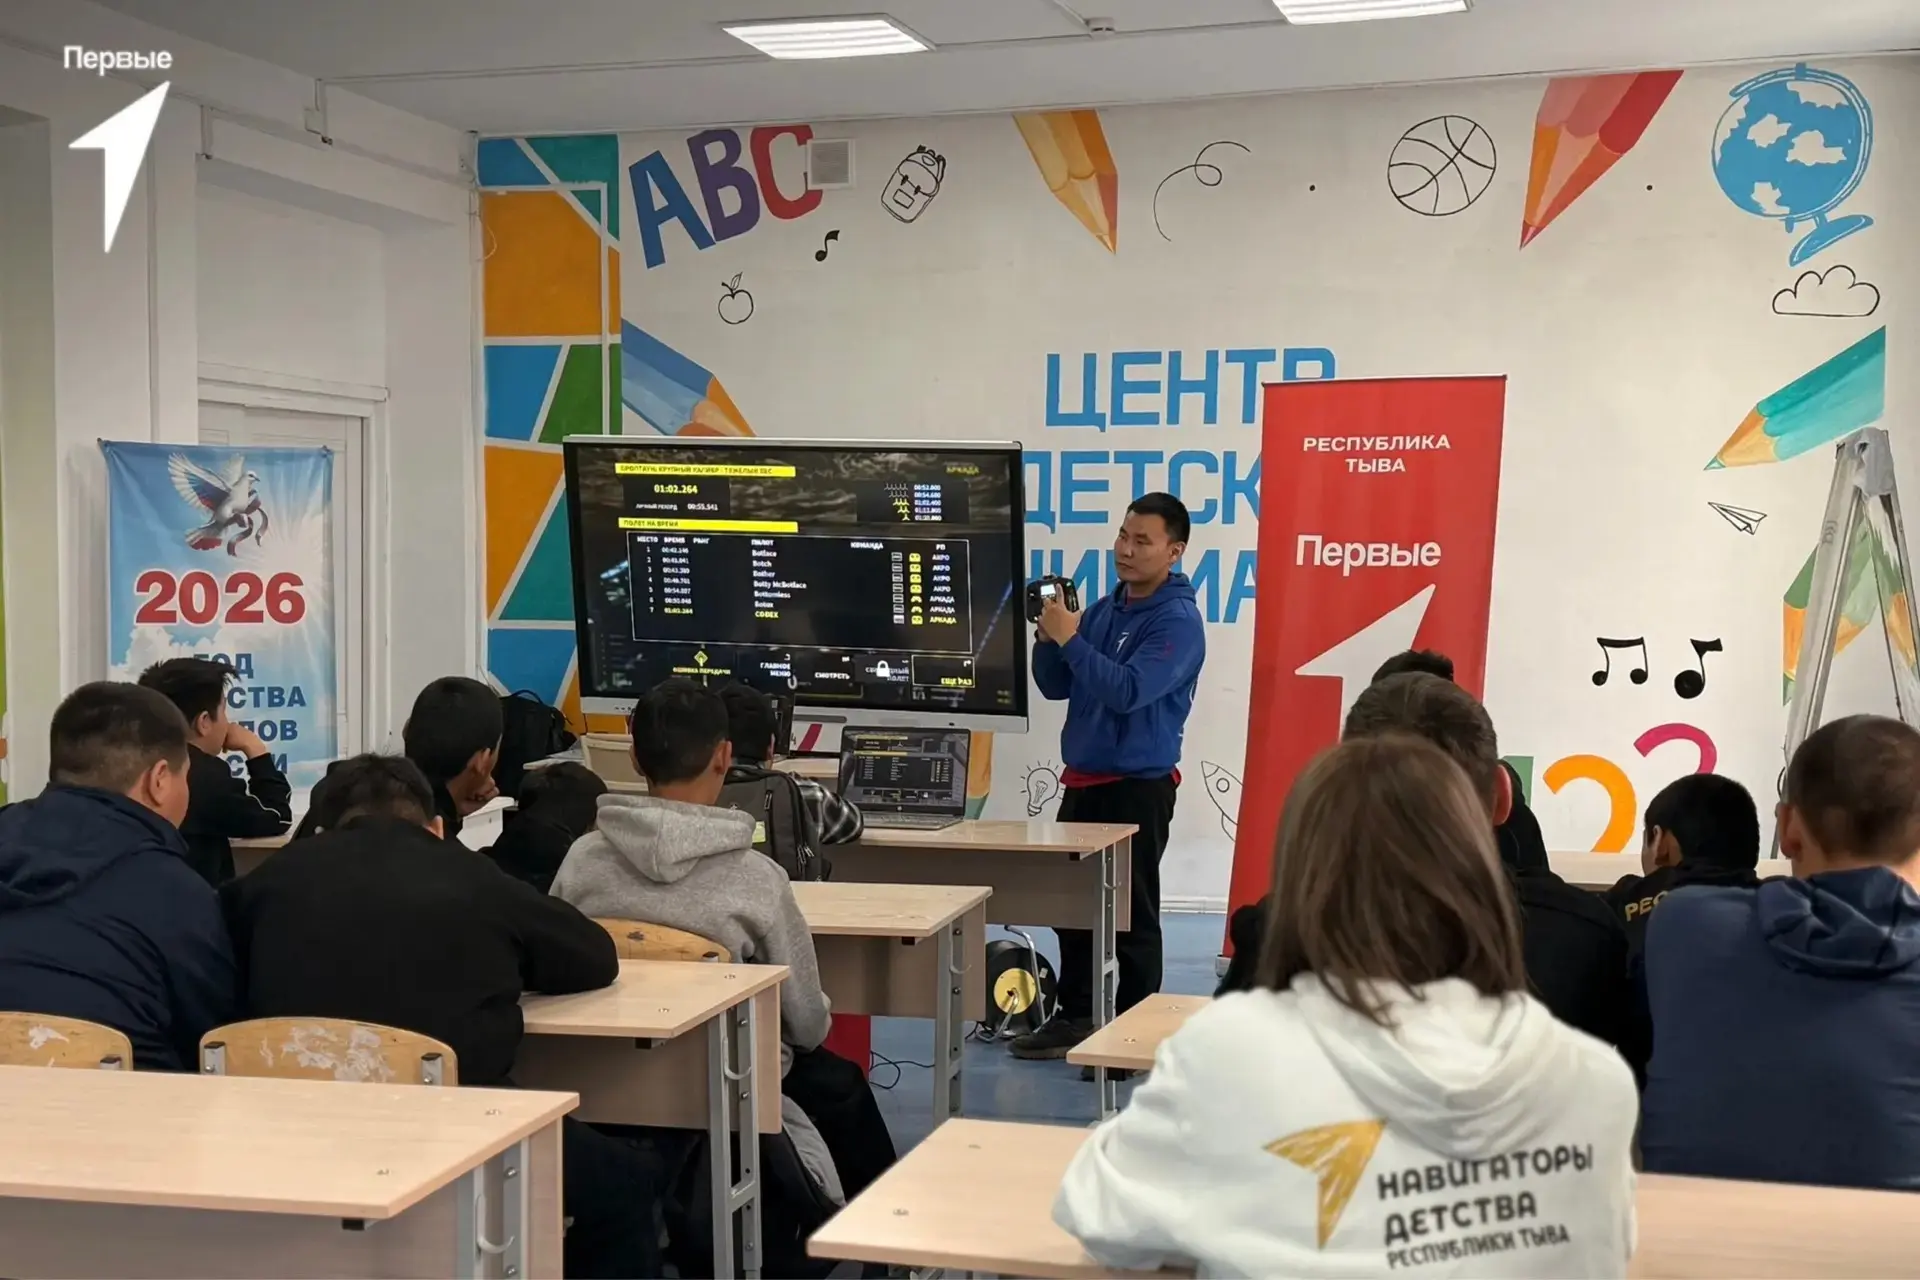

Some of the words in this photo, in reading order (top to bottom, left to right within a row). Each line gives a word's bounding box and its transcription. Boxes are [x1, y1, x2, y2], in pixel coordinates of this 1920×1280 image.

[628, 124, 824, 269] ABC
[1302, 434, 1451, 452] РЕСПУБЛИКА
[1345, 457, 1406, 473] ТЫВА
[653, 484, 698, 494] 01:02.264
[1021, 450, 1261, 534] ДЕТСК
[1296, 534, 1442, 577] Первые
[135, 569, 306, 625] 2026
[759, 662, 791, 670] ГЛАВНОЕ
[815, 672, 850, 680] СМОТРЕТЬ
[227, 686, 307, 709] СТВА
[1377, 1143, 1593, 1200] НАВИГАТОРЫ
[1384, 1191, 1538, 1247] ДЕТСТВА
[1386, 1231, 1516, 1270] РЕСПУБЛИКИ
[1517, 1223, 1571, 1249] ТЫВА
